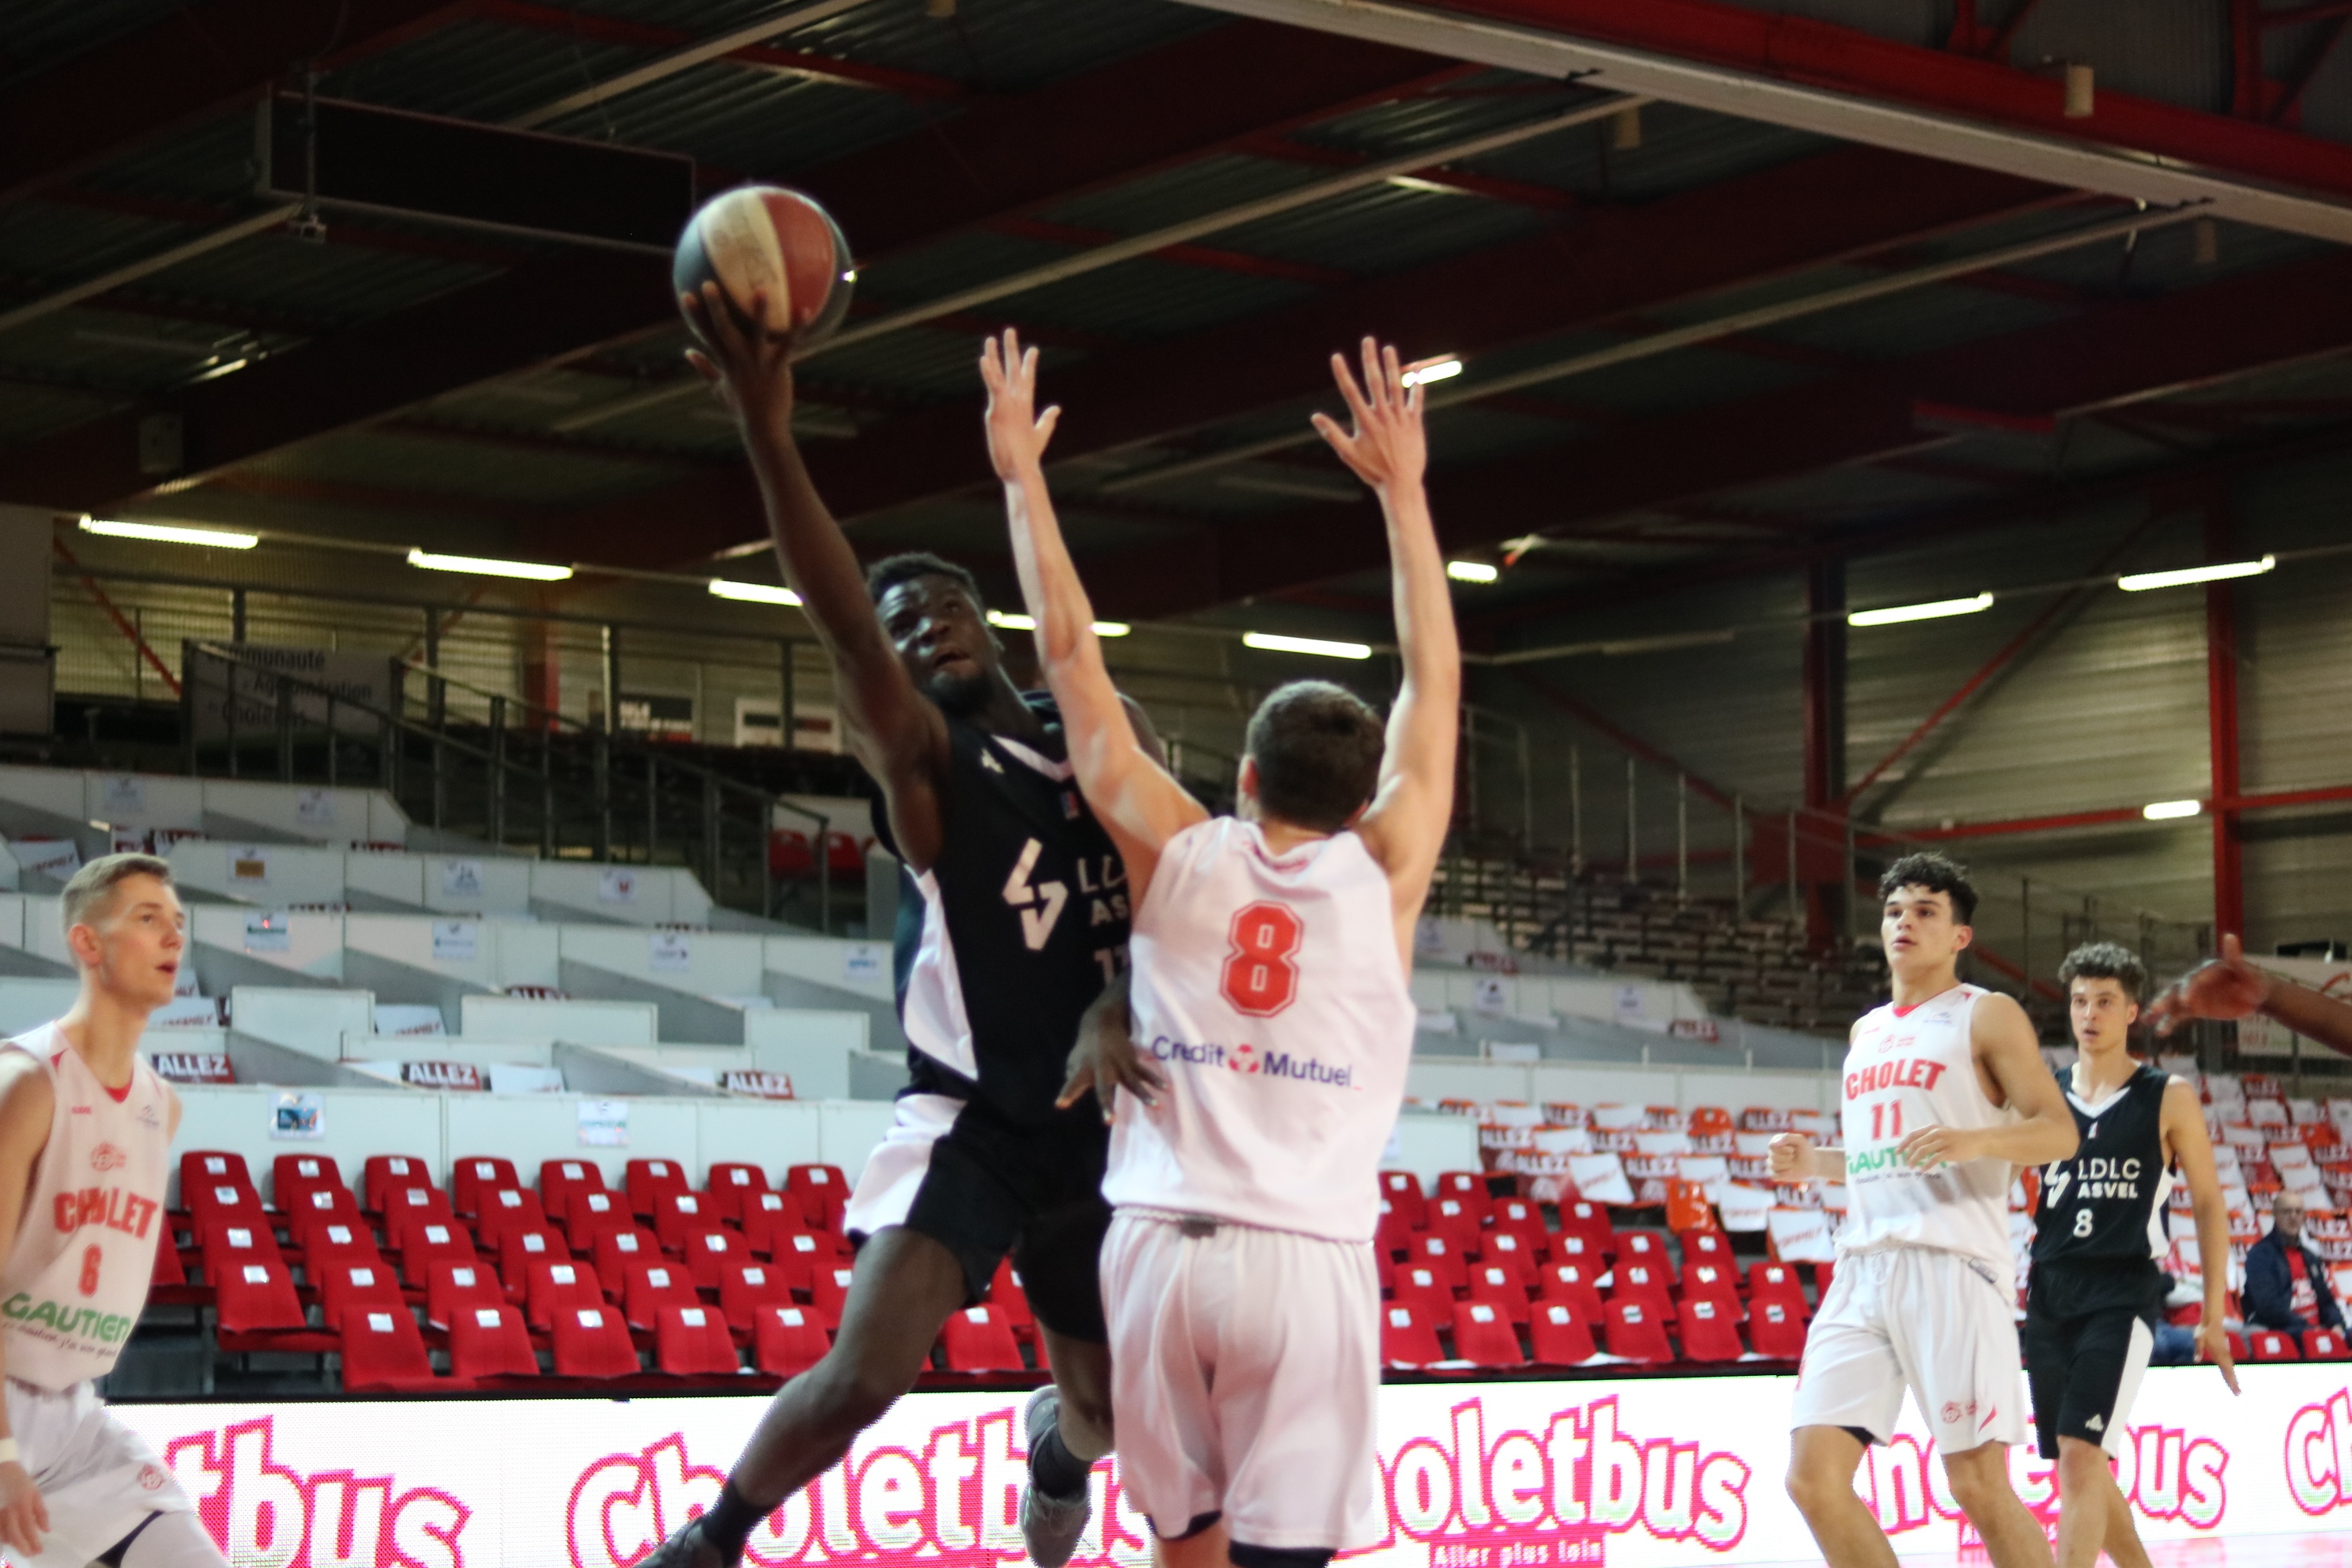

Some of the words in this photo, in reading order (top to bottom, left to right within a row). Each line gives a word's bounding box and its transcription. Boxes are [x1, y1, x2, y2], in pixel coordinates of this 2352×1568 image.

[1219, 899, 1304, 1018] 8
[157, 1055, 228, 1077] ALLEZ
[409, 1064, 475, 1085] ALLEZ
[1263, 1051, 1352, 1087] Mutuel
[1845, 1059, 1947, 1100] CHOLET
[727, 1074, 788, 1094] ALLEZ
[1871, 1099, 1903, 1140] 11
[2078, 1157, 2142, 1181] LDLC
[2077, 1182, 2139, 1199] ASVEL
[2073, 1208, 2094, 1238] 8
[78, 1243, 102, 1298] 6
